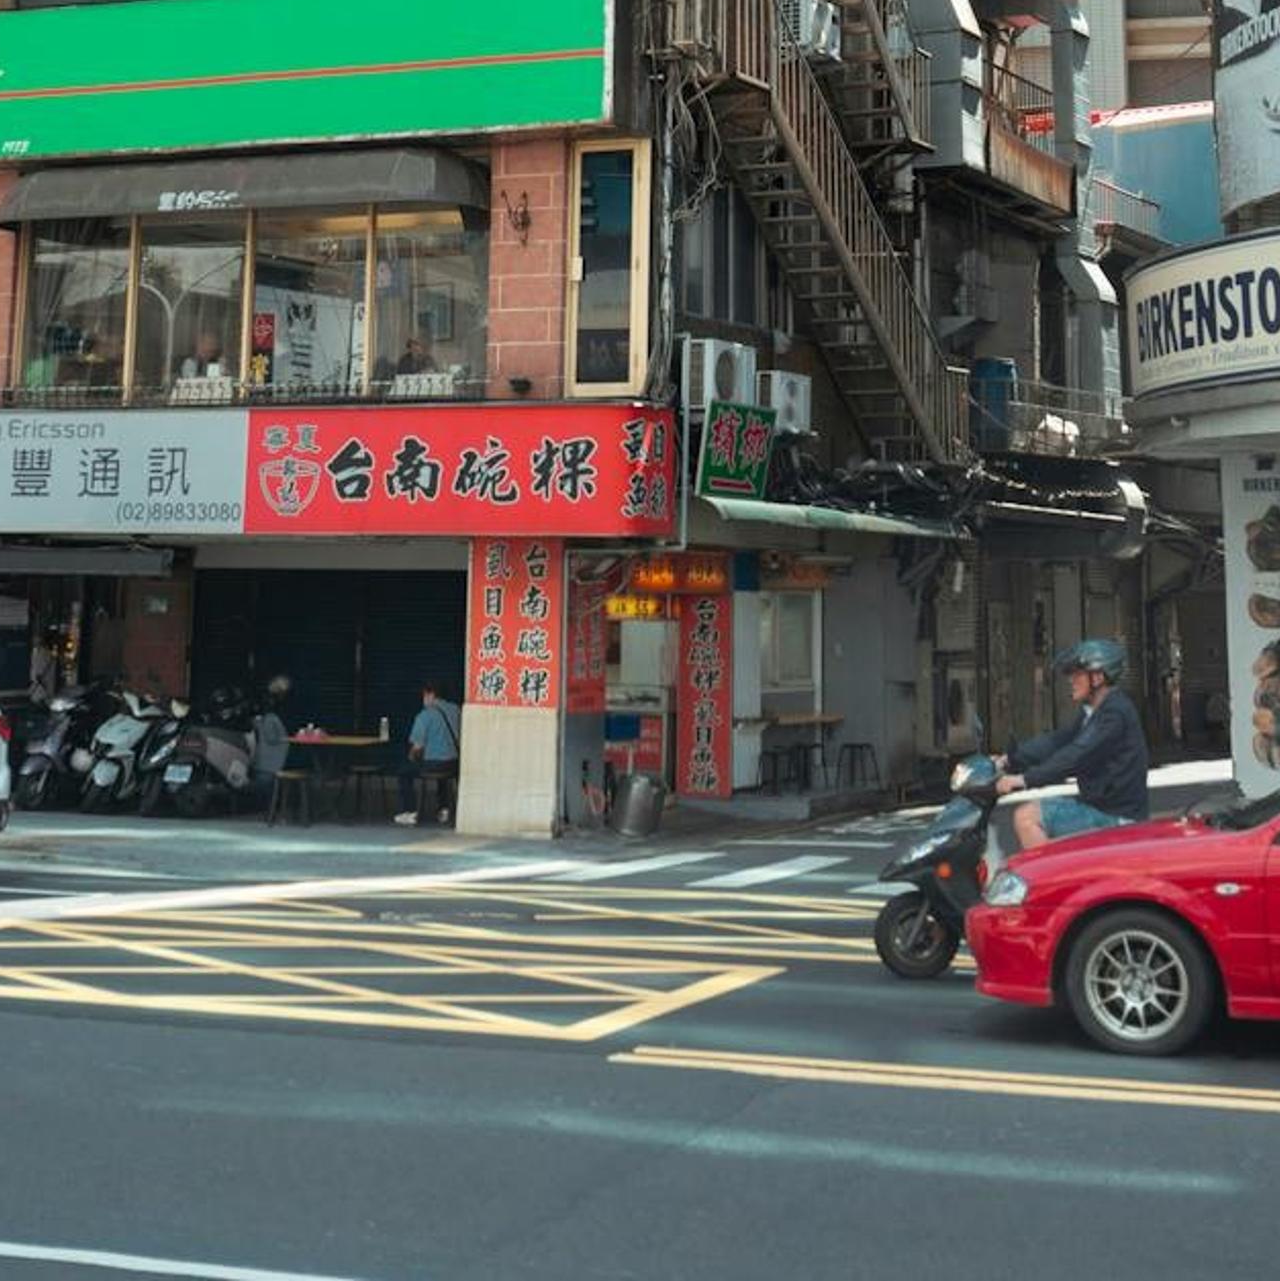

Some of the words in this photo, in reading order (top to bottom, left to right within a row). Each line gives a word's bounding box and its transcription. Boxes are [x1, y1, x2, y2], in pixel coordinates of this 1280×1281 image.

[8, 419, 106, 440] Ericsson
[710, 408, 770, 478] 檳榔
[325, 433, 600, 506] 台南碗粿
[116, 501, 242, 522] (02)89833080
[516, 543, 553, 704] 台南碗粿
